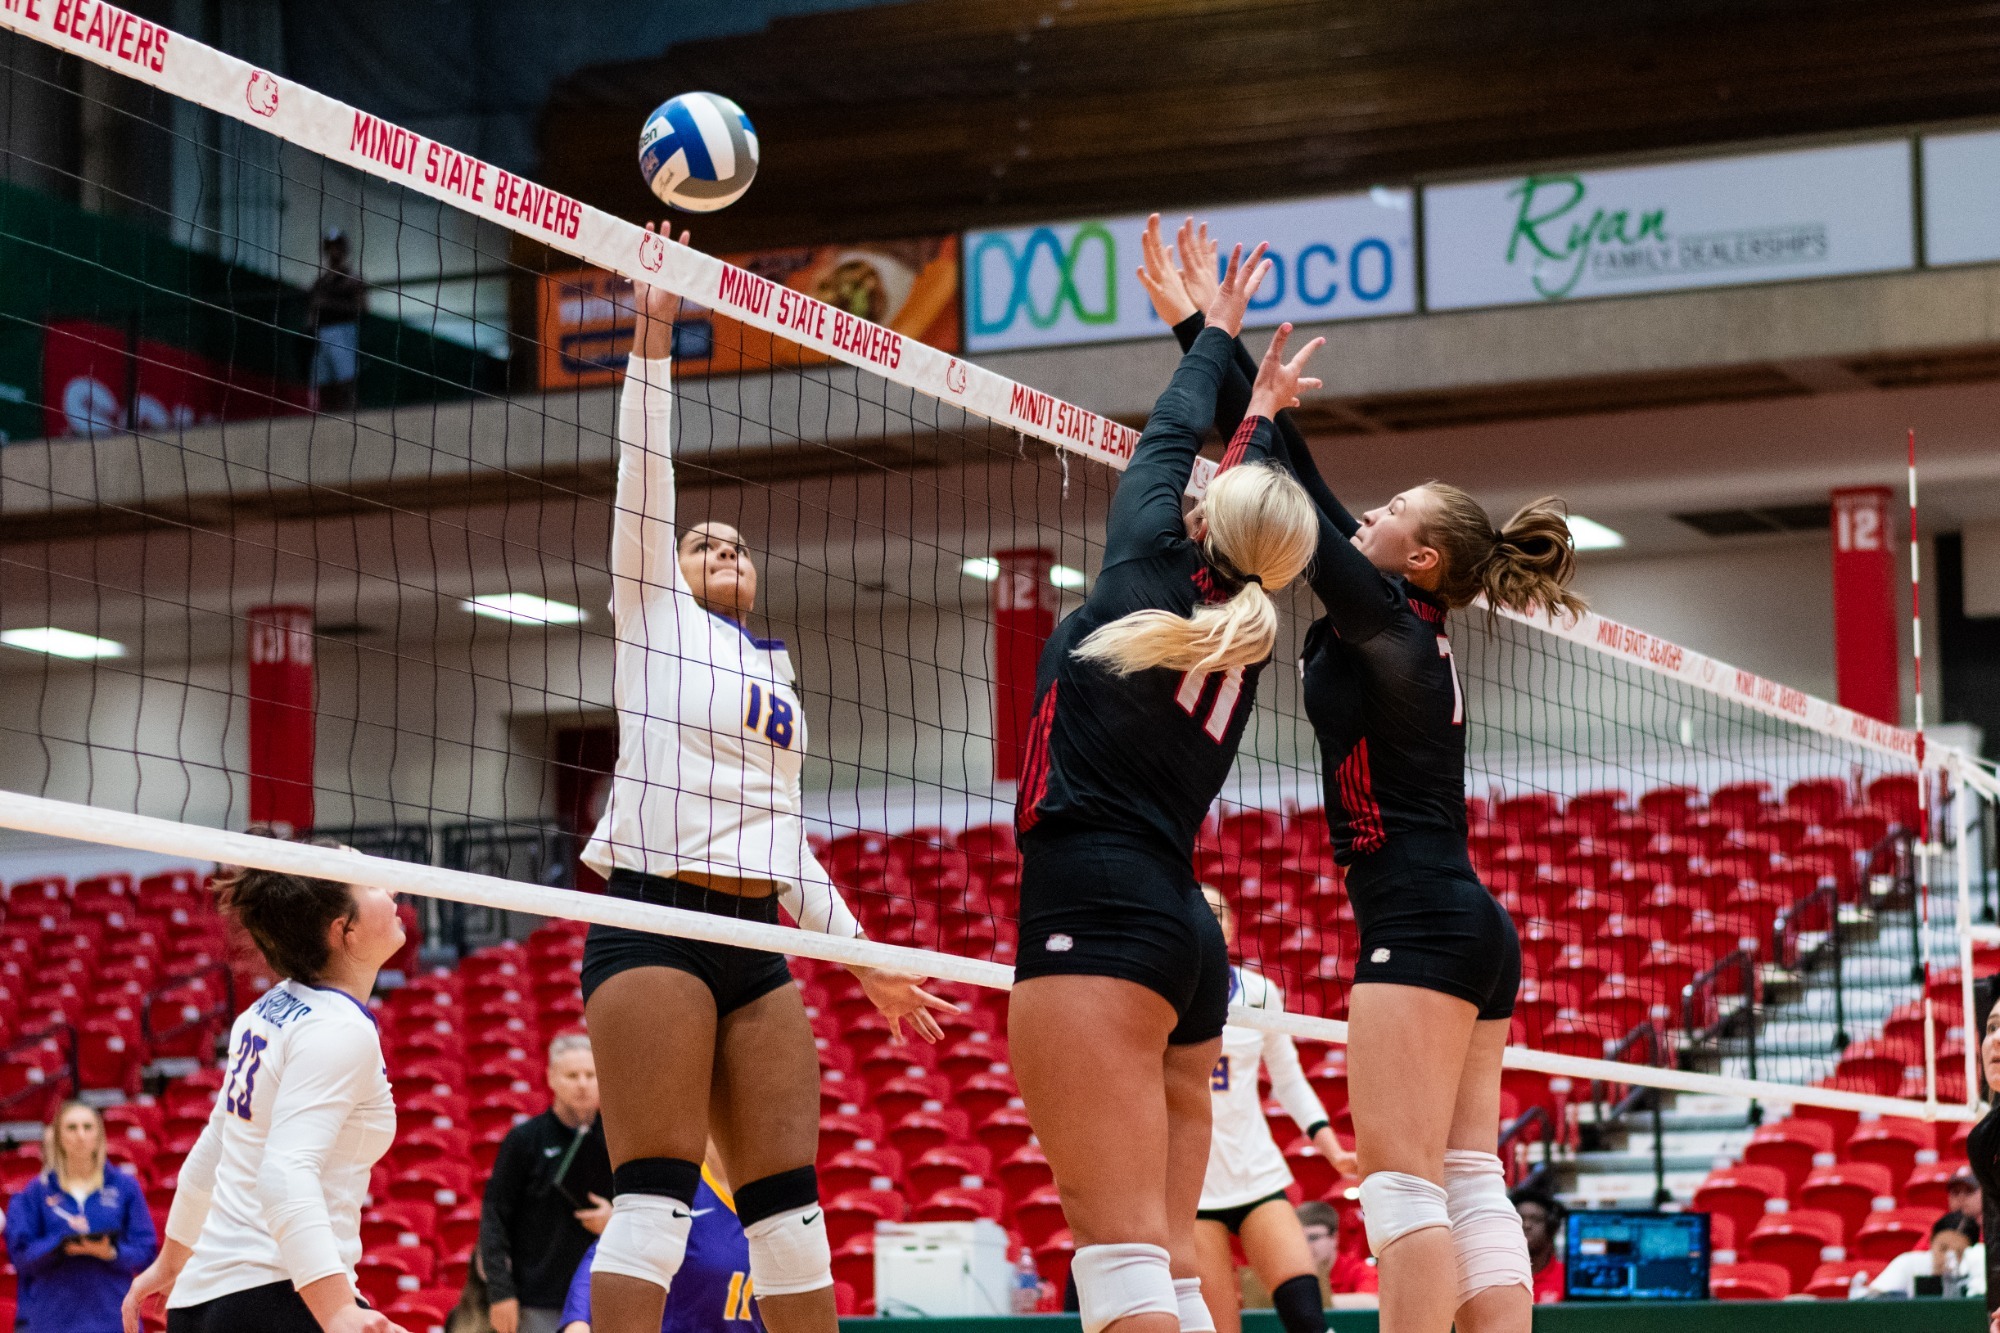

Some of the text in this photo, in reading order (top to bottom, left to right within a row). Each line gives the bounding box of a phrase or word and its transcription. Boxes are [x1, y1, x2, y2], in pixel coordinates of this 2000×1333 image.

[53, 0, 169, 73] BEAVERS
[350, 110, 583, 241] MINOT STATE BEAVERS
[1506, 173, 1669, 298] Ryan
[1593, 248, 1672, 273] FAMILY
[1219, 238, 1393, 312] DCO
[718, 265, 902, 370] MINOT STATE BEAVERS
[1009, 382, 1141, 460] MINOT STATE BEAV
[1838, 508, 1879, 552] 12
[743, 680, 794, 751] 18
